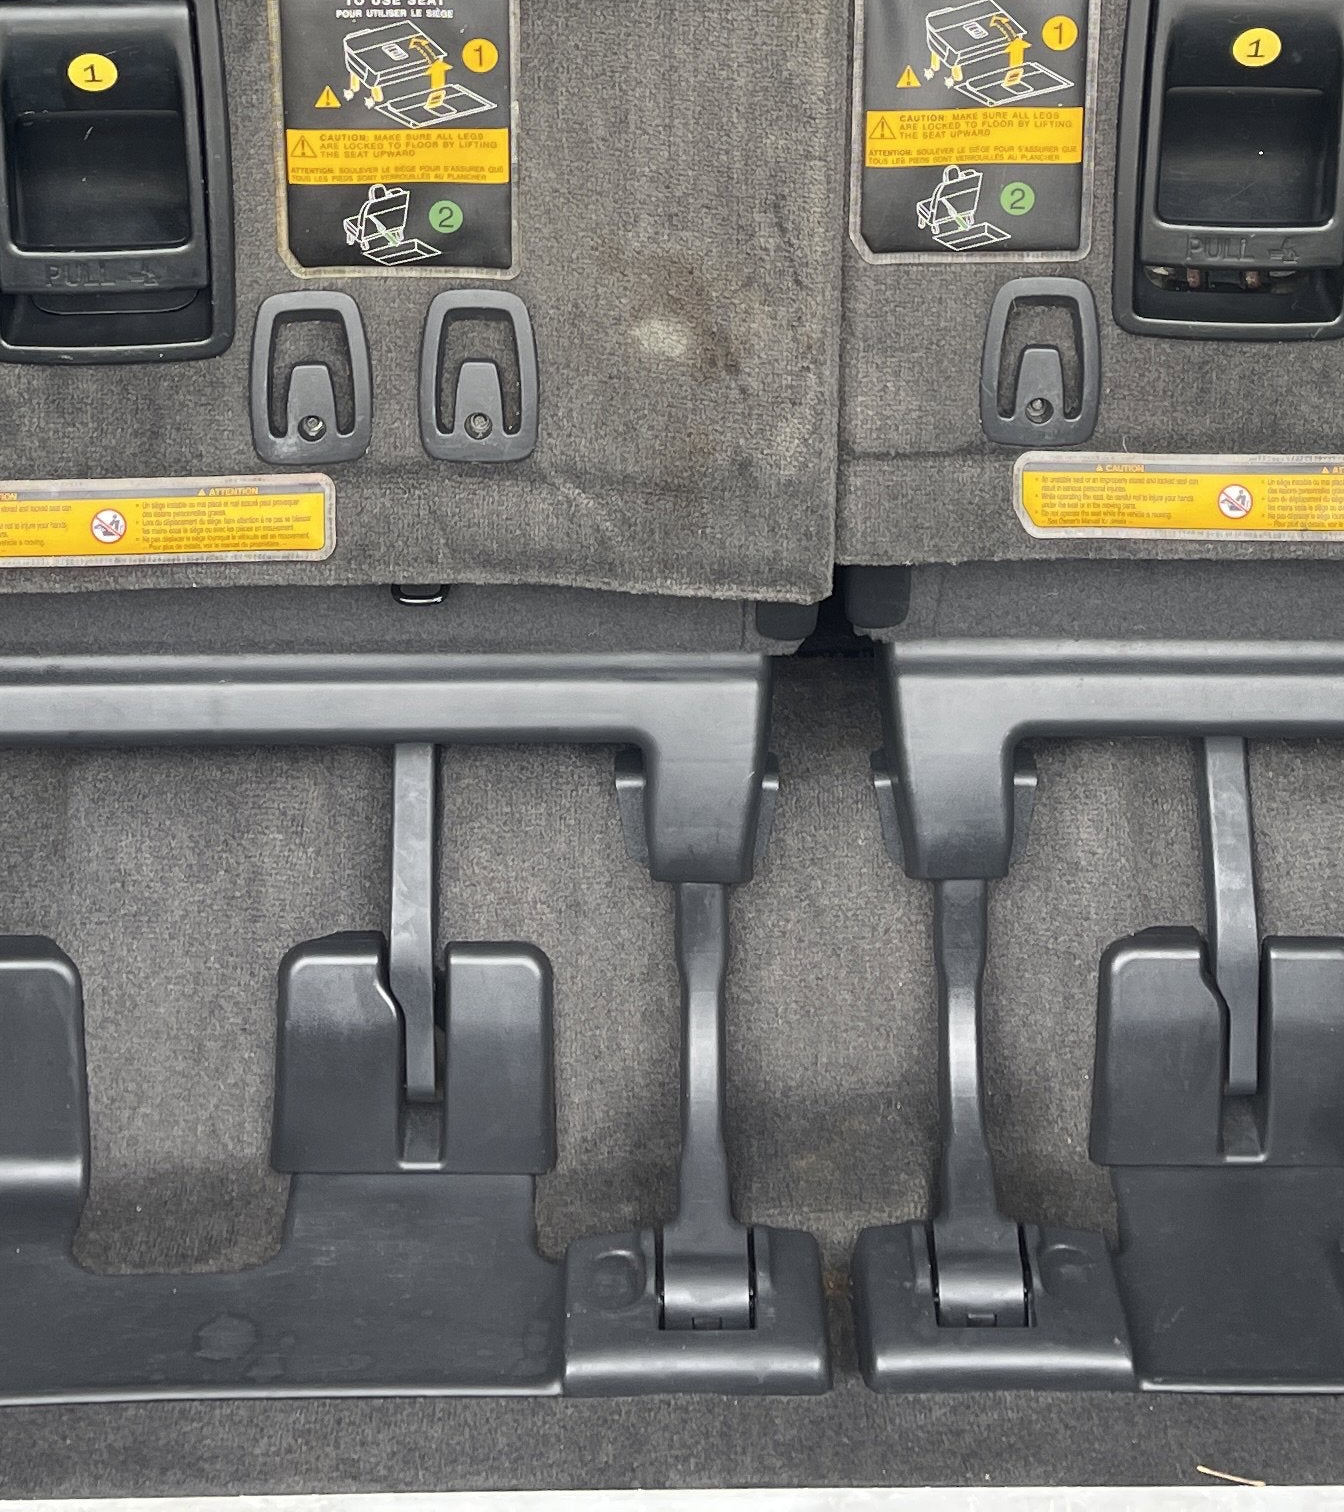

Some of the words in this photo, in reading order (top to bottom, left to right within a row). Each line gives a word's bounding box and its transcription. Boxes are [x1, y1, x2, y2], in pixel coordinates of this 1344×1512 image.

[336, 9, 362, 18] POUR
[366, 9, 407, 18] UTILISER
[411, 9, 422, 18] LE
[1054, 22, 1064, 44] 1
[1246, 39, 1264, 58] 1
[473, 46, 483, 66] 1
[83, 64, 103, 83] 1
[982, 113, 1008, 121] SURE
[1033, 112, 1060, 120] LEGS
[900, 123, 919, 131] ARE
[922, 122, 960, 130] LOCKED
[982, 121, 1014, 129] FLOOR
[1034, 120, 1072, 128] LIFTING
[374, 134, 401, 142] MAKE
[436, 133, 453, 141] ALL
[457, 133, 484, 141] LEGS
[900, 131, 919, 139] THE
[923, 130, 946, 138] SEAT
[950, 129, 990, 138] UPWARD
[320, 142, 339, 150] ARE
[343, 142, 384, 150] LOCKED
[406, 141, 438, 149] FLOOR
[442, 141, 455, 149] BY
[458, 141, 497, 149] LIFTING
[320, 150, 341, 158] THE
[344, 150, 369, 158] SEAT
[1010, 188, 1025, 210] 2
[438, 207, 454, 228] 2
[1187, 236, 1255, 261] PULL
[209, 488, 259, 496] ATTENTION
